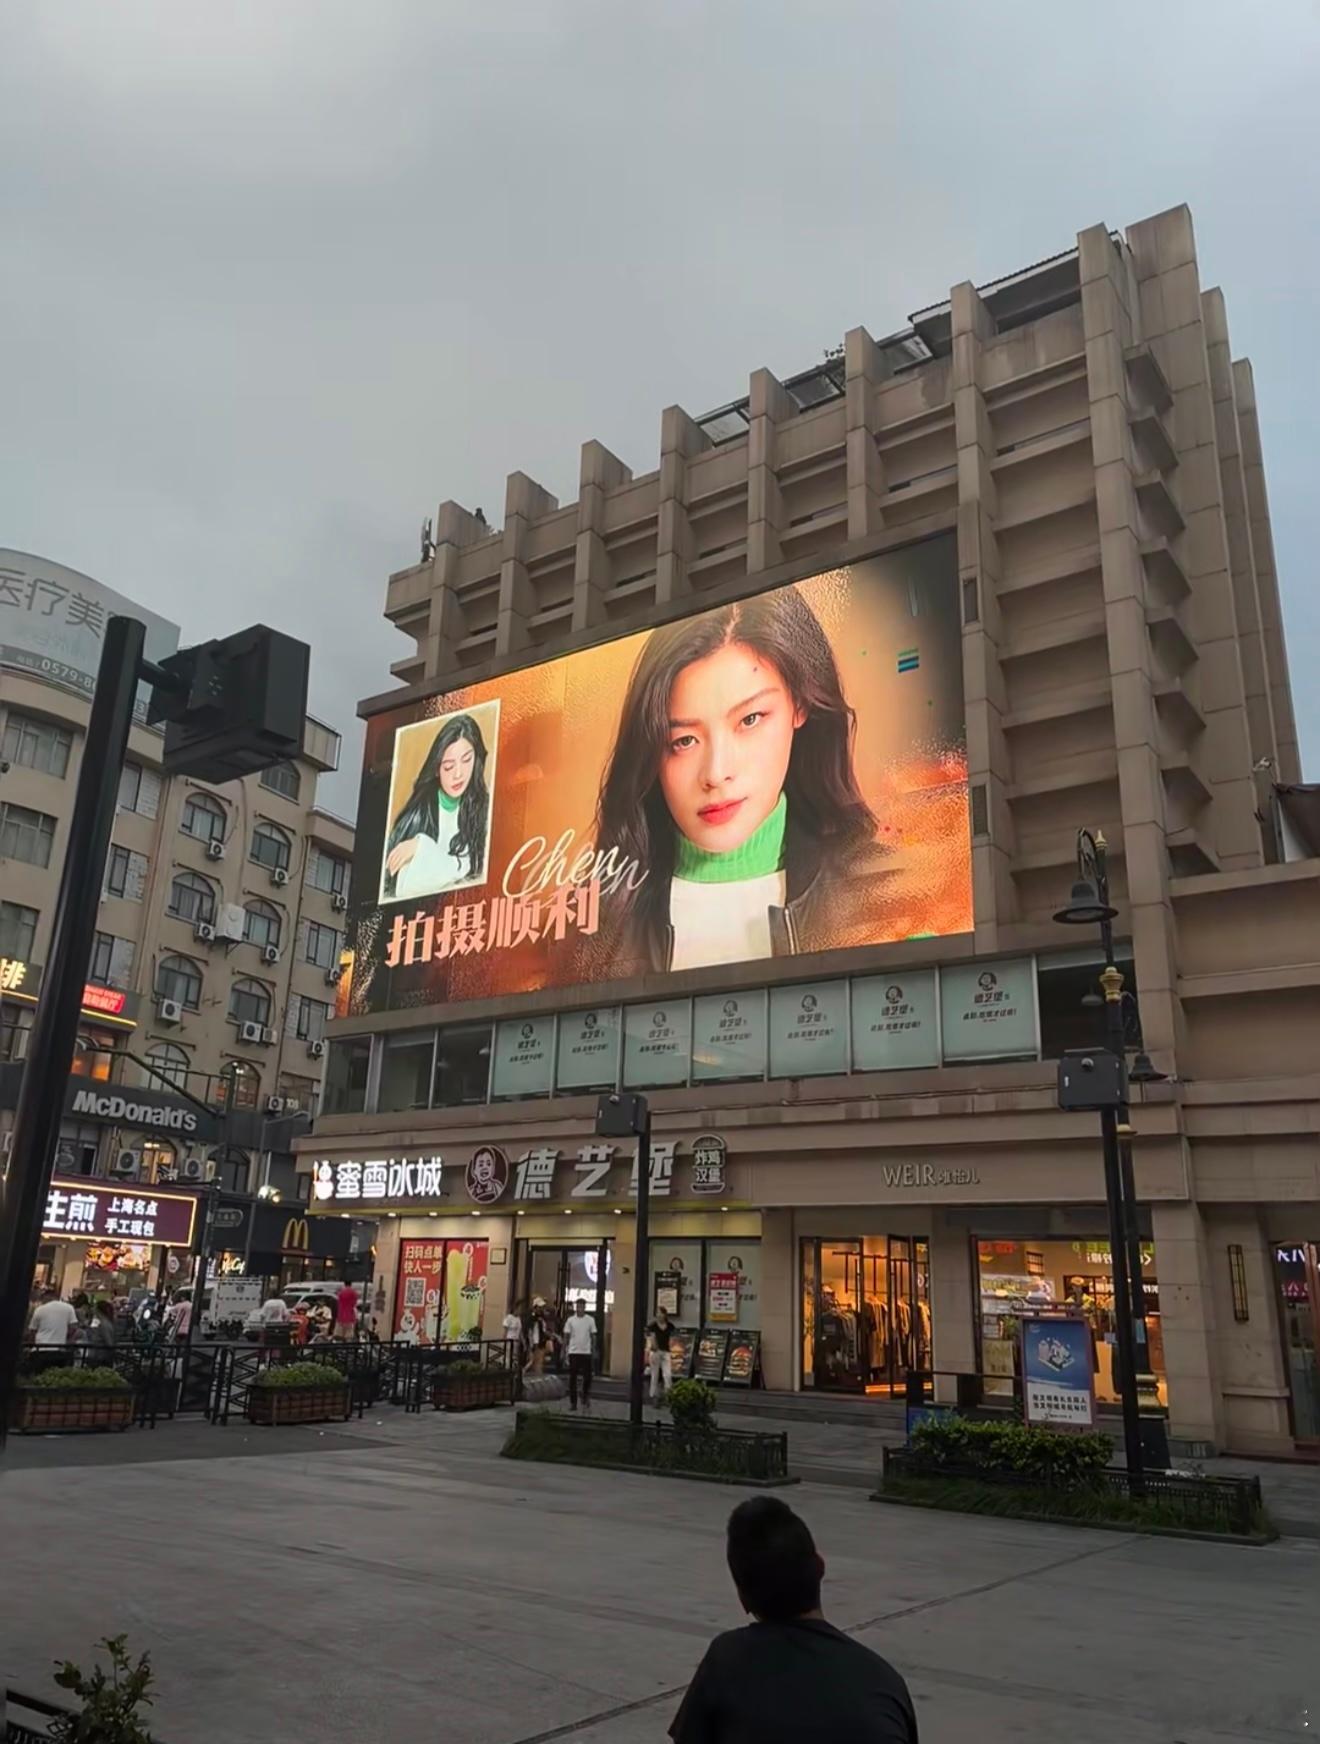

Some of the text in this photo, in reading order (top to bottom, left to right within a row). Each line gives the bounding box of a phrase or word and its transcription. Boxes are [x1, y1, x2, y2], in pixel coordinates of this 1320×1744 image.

[0, 567, 116, 639] 医疗美
[41, 658, 97, 691] 0579-8
[502, 828, 633, 898] Chen
[384, 879, 601, 969] 拍摄顺利
[72, 1090, 197, 1131] McDonald's
[335, 1156, 443, 1199] 蜜雪冰城
[514, 1142, 678, 1200] 德艺堡
[694, 1149, 722, 1167] 炸鸡
[694, 1167, 722, 1184] 汉堡
[883, 1163, 937, 1187] WEIR
[43, 1190, 98, 1232] 生煎
[104, 1217, 156, 1237] 手工现包
[107, 1196, 159, 1217] 上海名点
